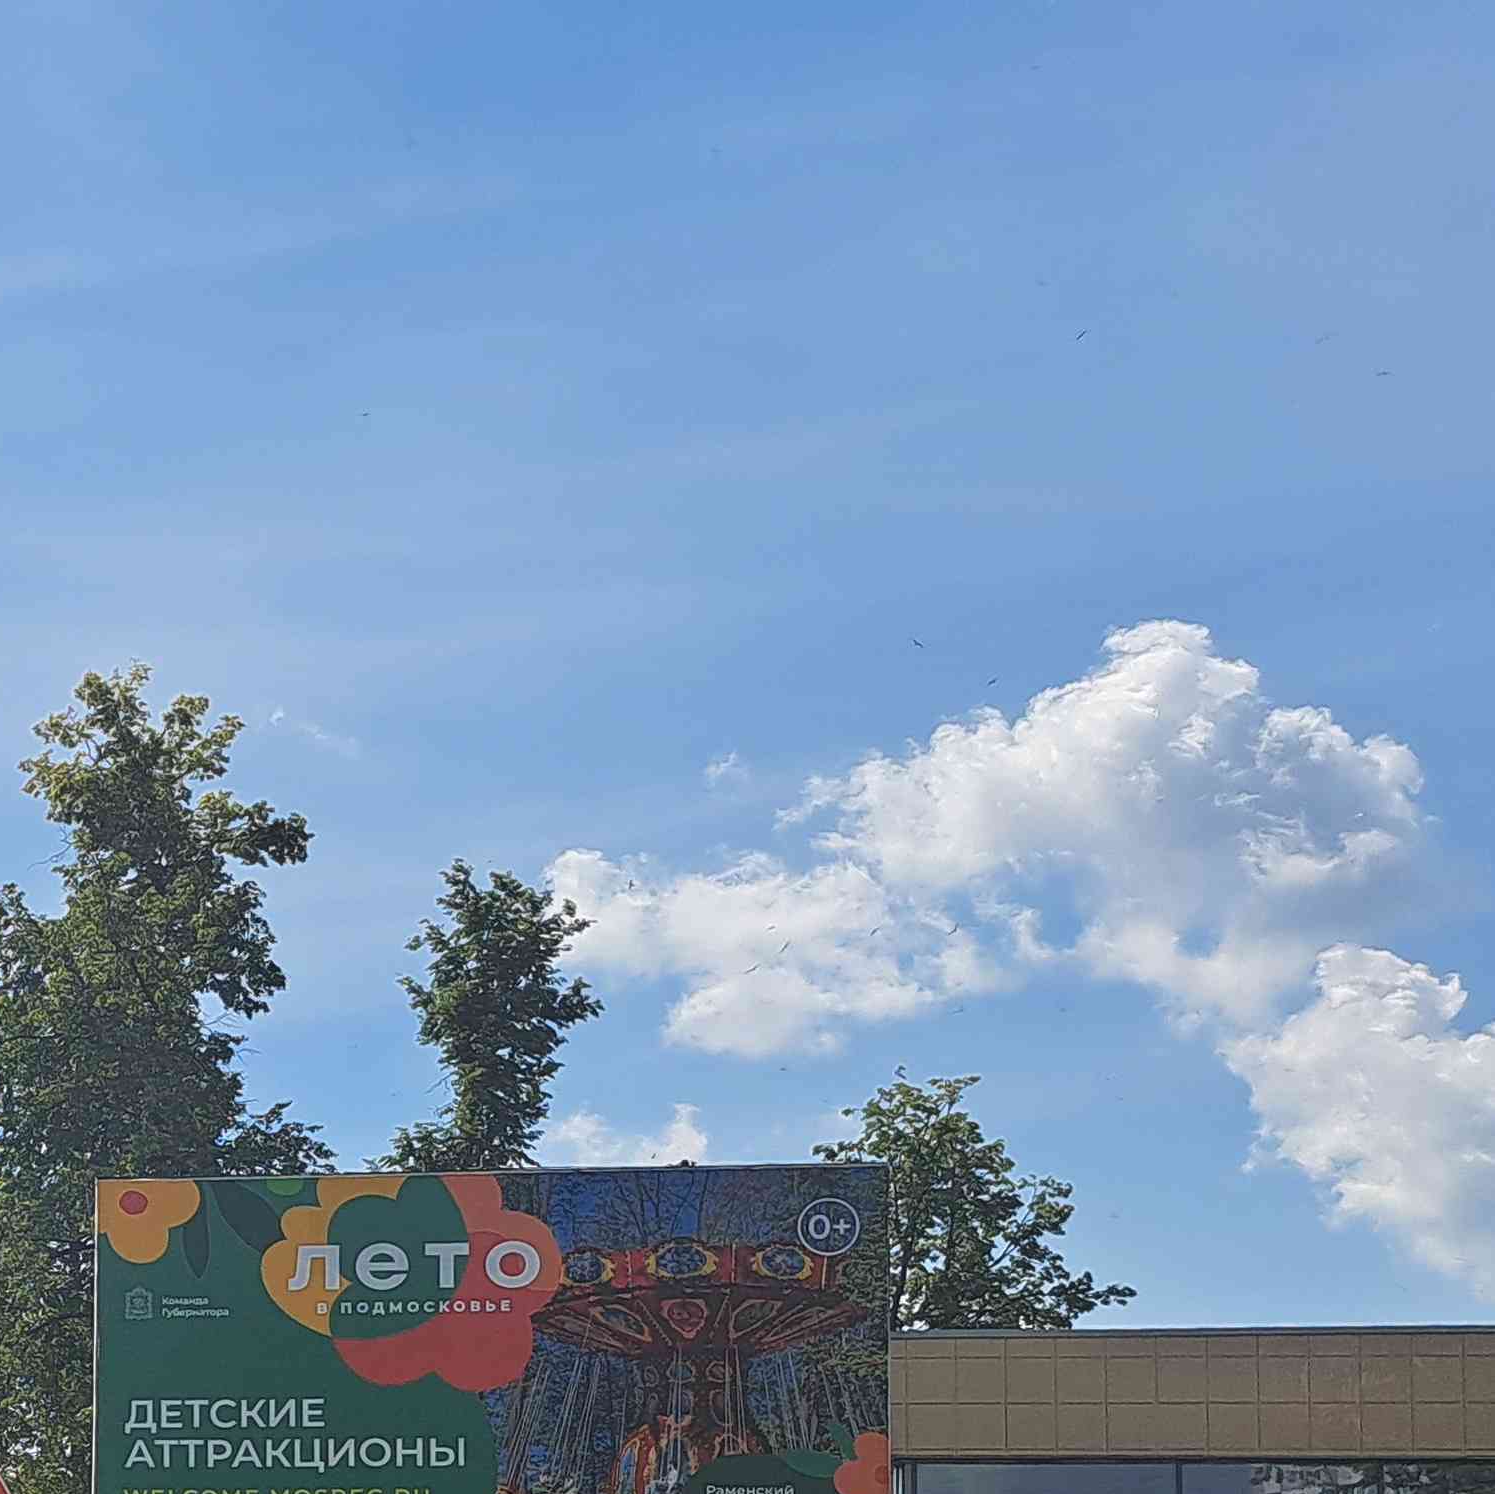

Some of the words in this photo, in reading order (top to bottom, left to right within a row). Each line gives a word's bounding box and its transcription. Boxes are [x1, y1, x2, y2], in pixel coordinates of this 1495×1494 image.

[808, 1214, 851, 1240] 0+
[162, 1296, 209, 1306] Команда
[340, 1300, 512, 1315] ПОДМОСКОВЬЕ
[162, 1307, 229, 1318] Губернатора
[124, 1398, 326, 1435] ДЕТСКИЕ
[124, 1437, 466, 1473] АТТРАКЦИОНЫ
